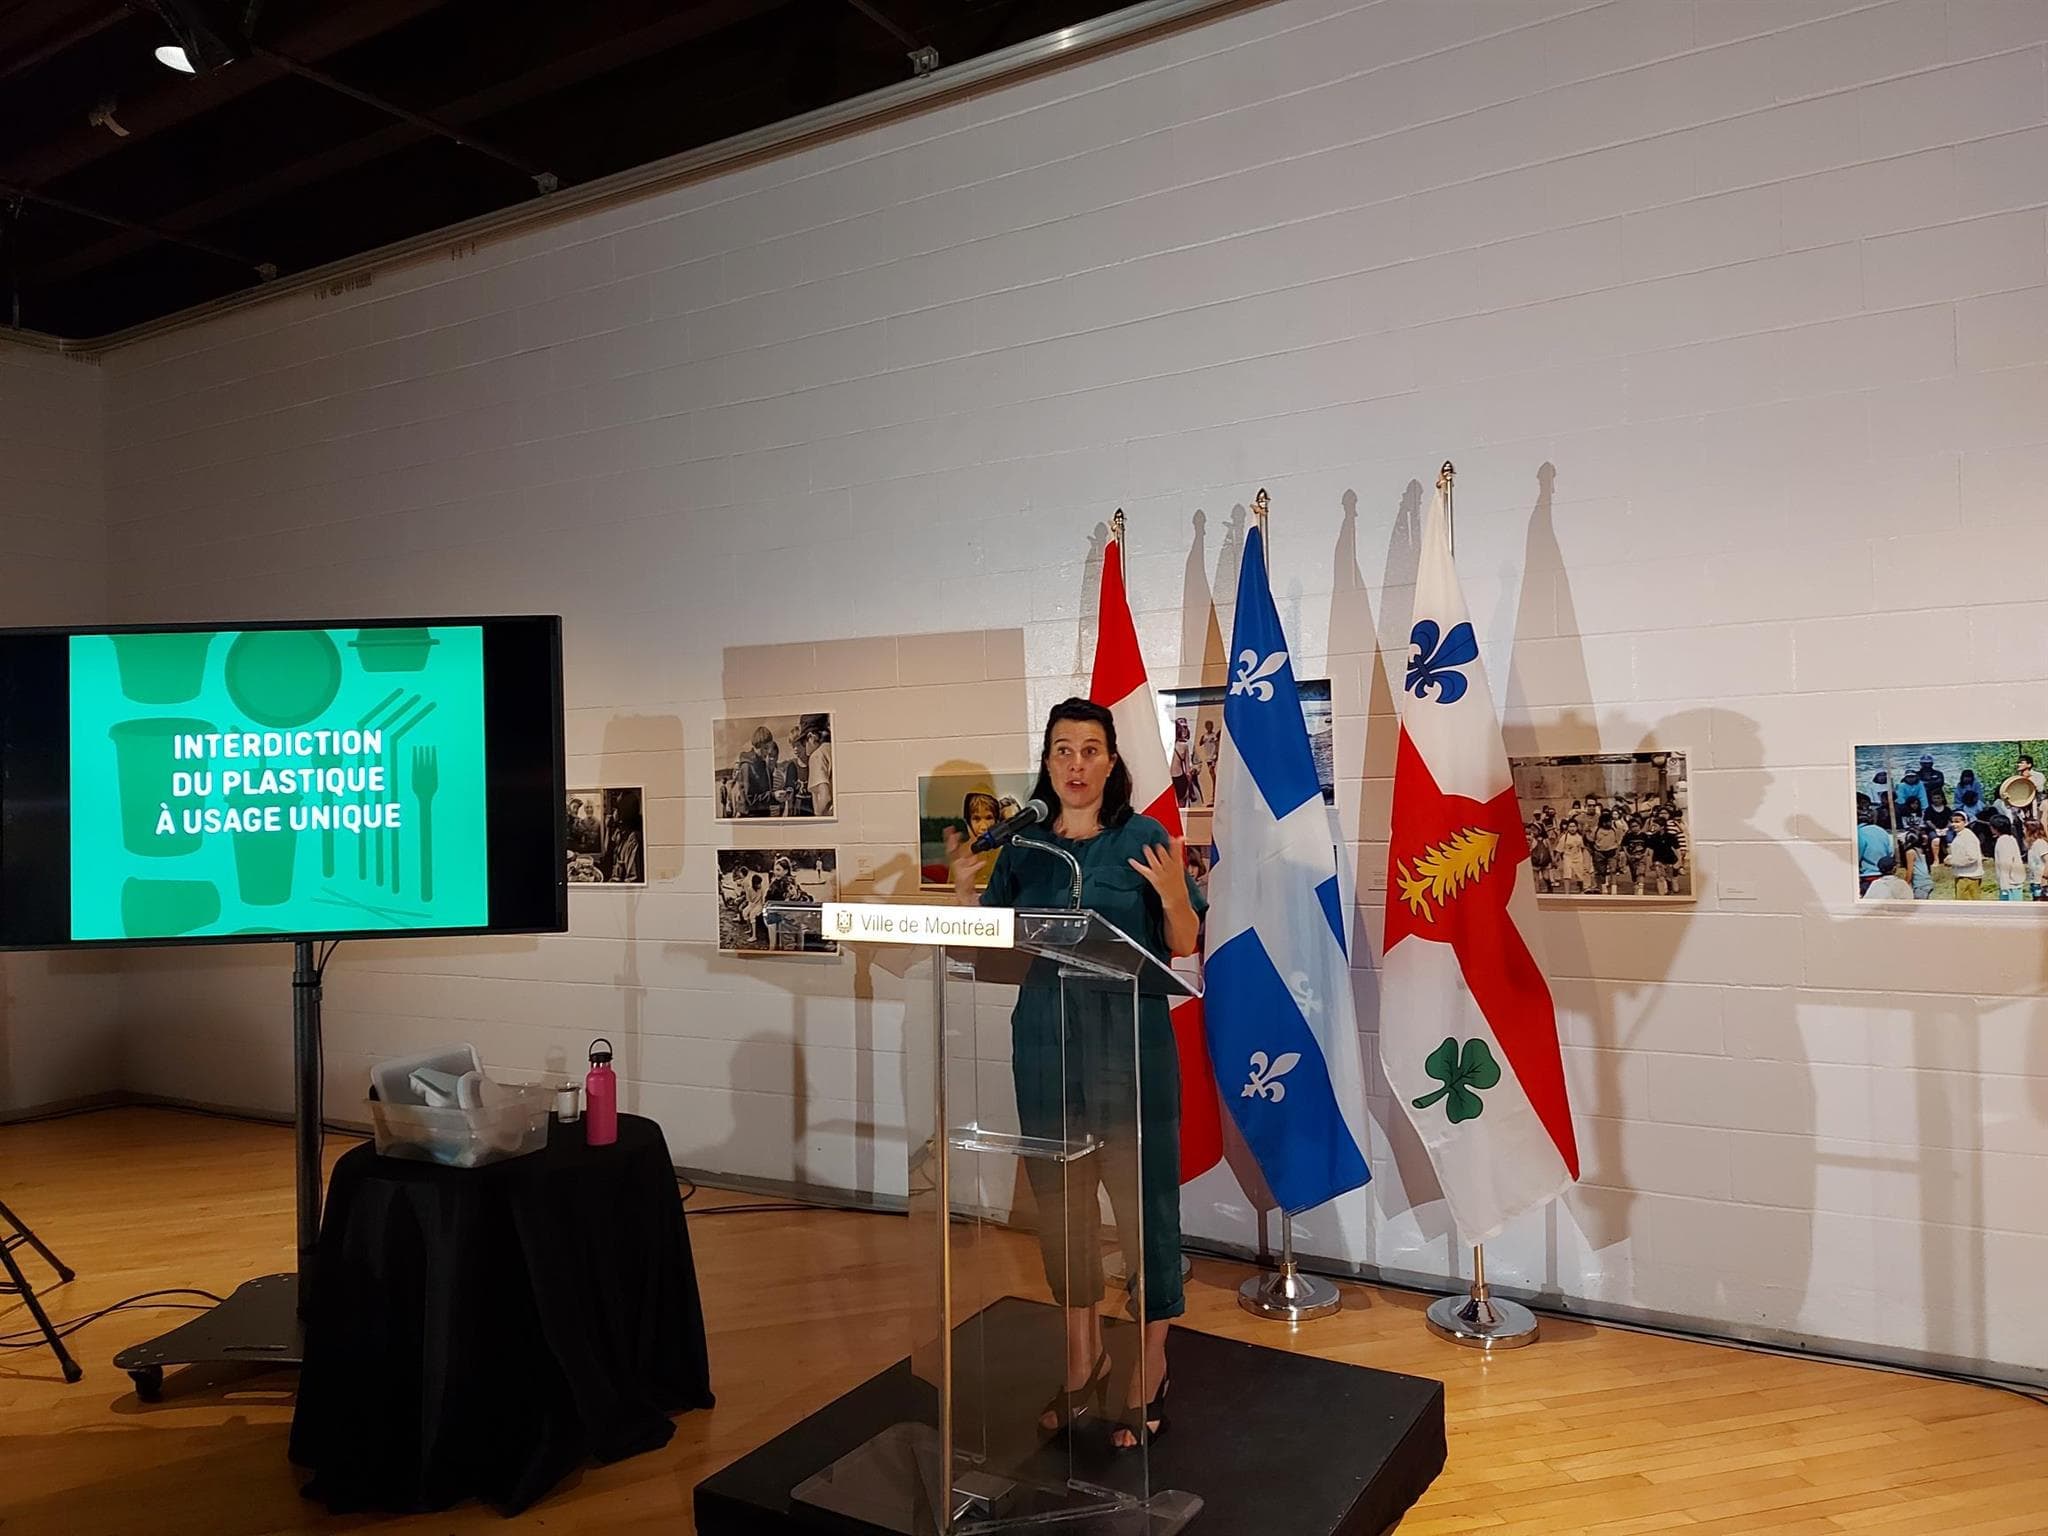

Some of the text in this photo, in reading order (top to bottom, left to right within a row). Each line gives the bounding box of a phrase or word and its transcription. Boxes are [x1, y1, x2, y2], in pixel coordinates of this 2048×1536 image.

[174, 729, 382, 759] INTERDICTION
[172, 766, 385, 797] DU PLASTIQUE
[155, 802, 402, 835] À USAGE UNIQUE
[861, 914, 1000, 937] Ville de Montréal
